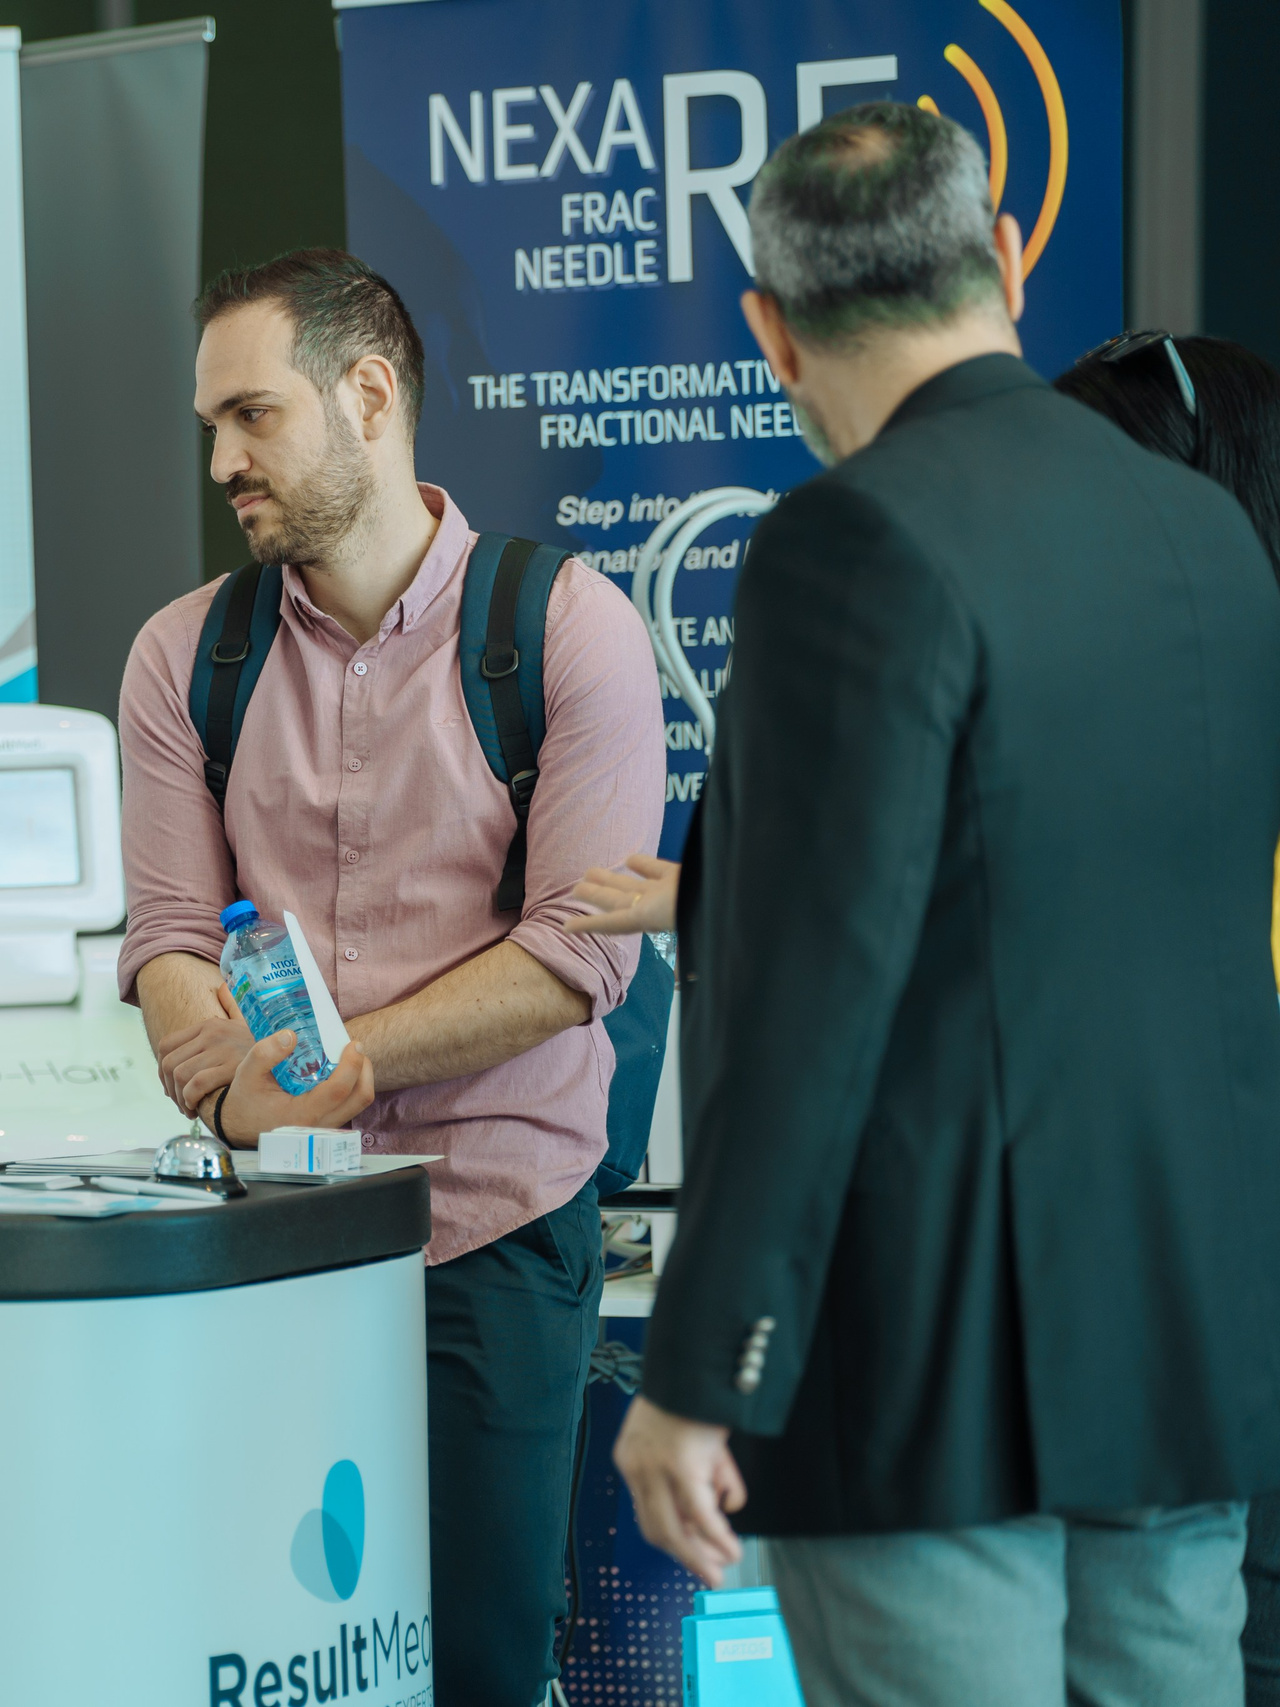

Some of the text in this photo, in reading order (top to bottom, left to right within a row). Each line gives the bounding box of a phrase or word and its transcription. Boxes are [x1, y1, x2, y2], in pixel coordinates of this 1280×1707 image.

[428, 78, 656, 186] NEXA
[562, 187, 656, 236] FRAC
[514, 240, 658, 290] NEEDLE
[468, 359, 780, 410] THE TRANSFORMATIV
[540, 406, 724, 449] FRACTIONAL
[556, 495, 624, 530] Step
[683, 538, 740, 570] and
[270, 959, 297, 970] ΑΓΙΟΣ
